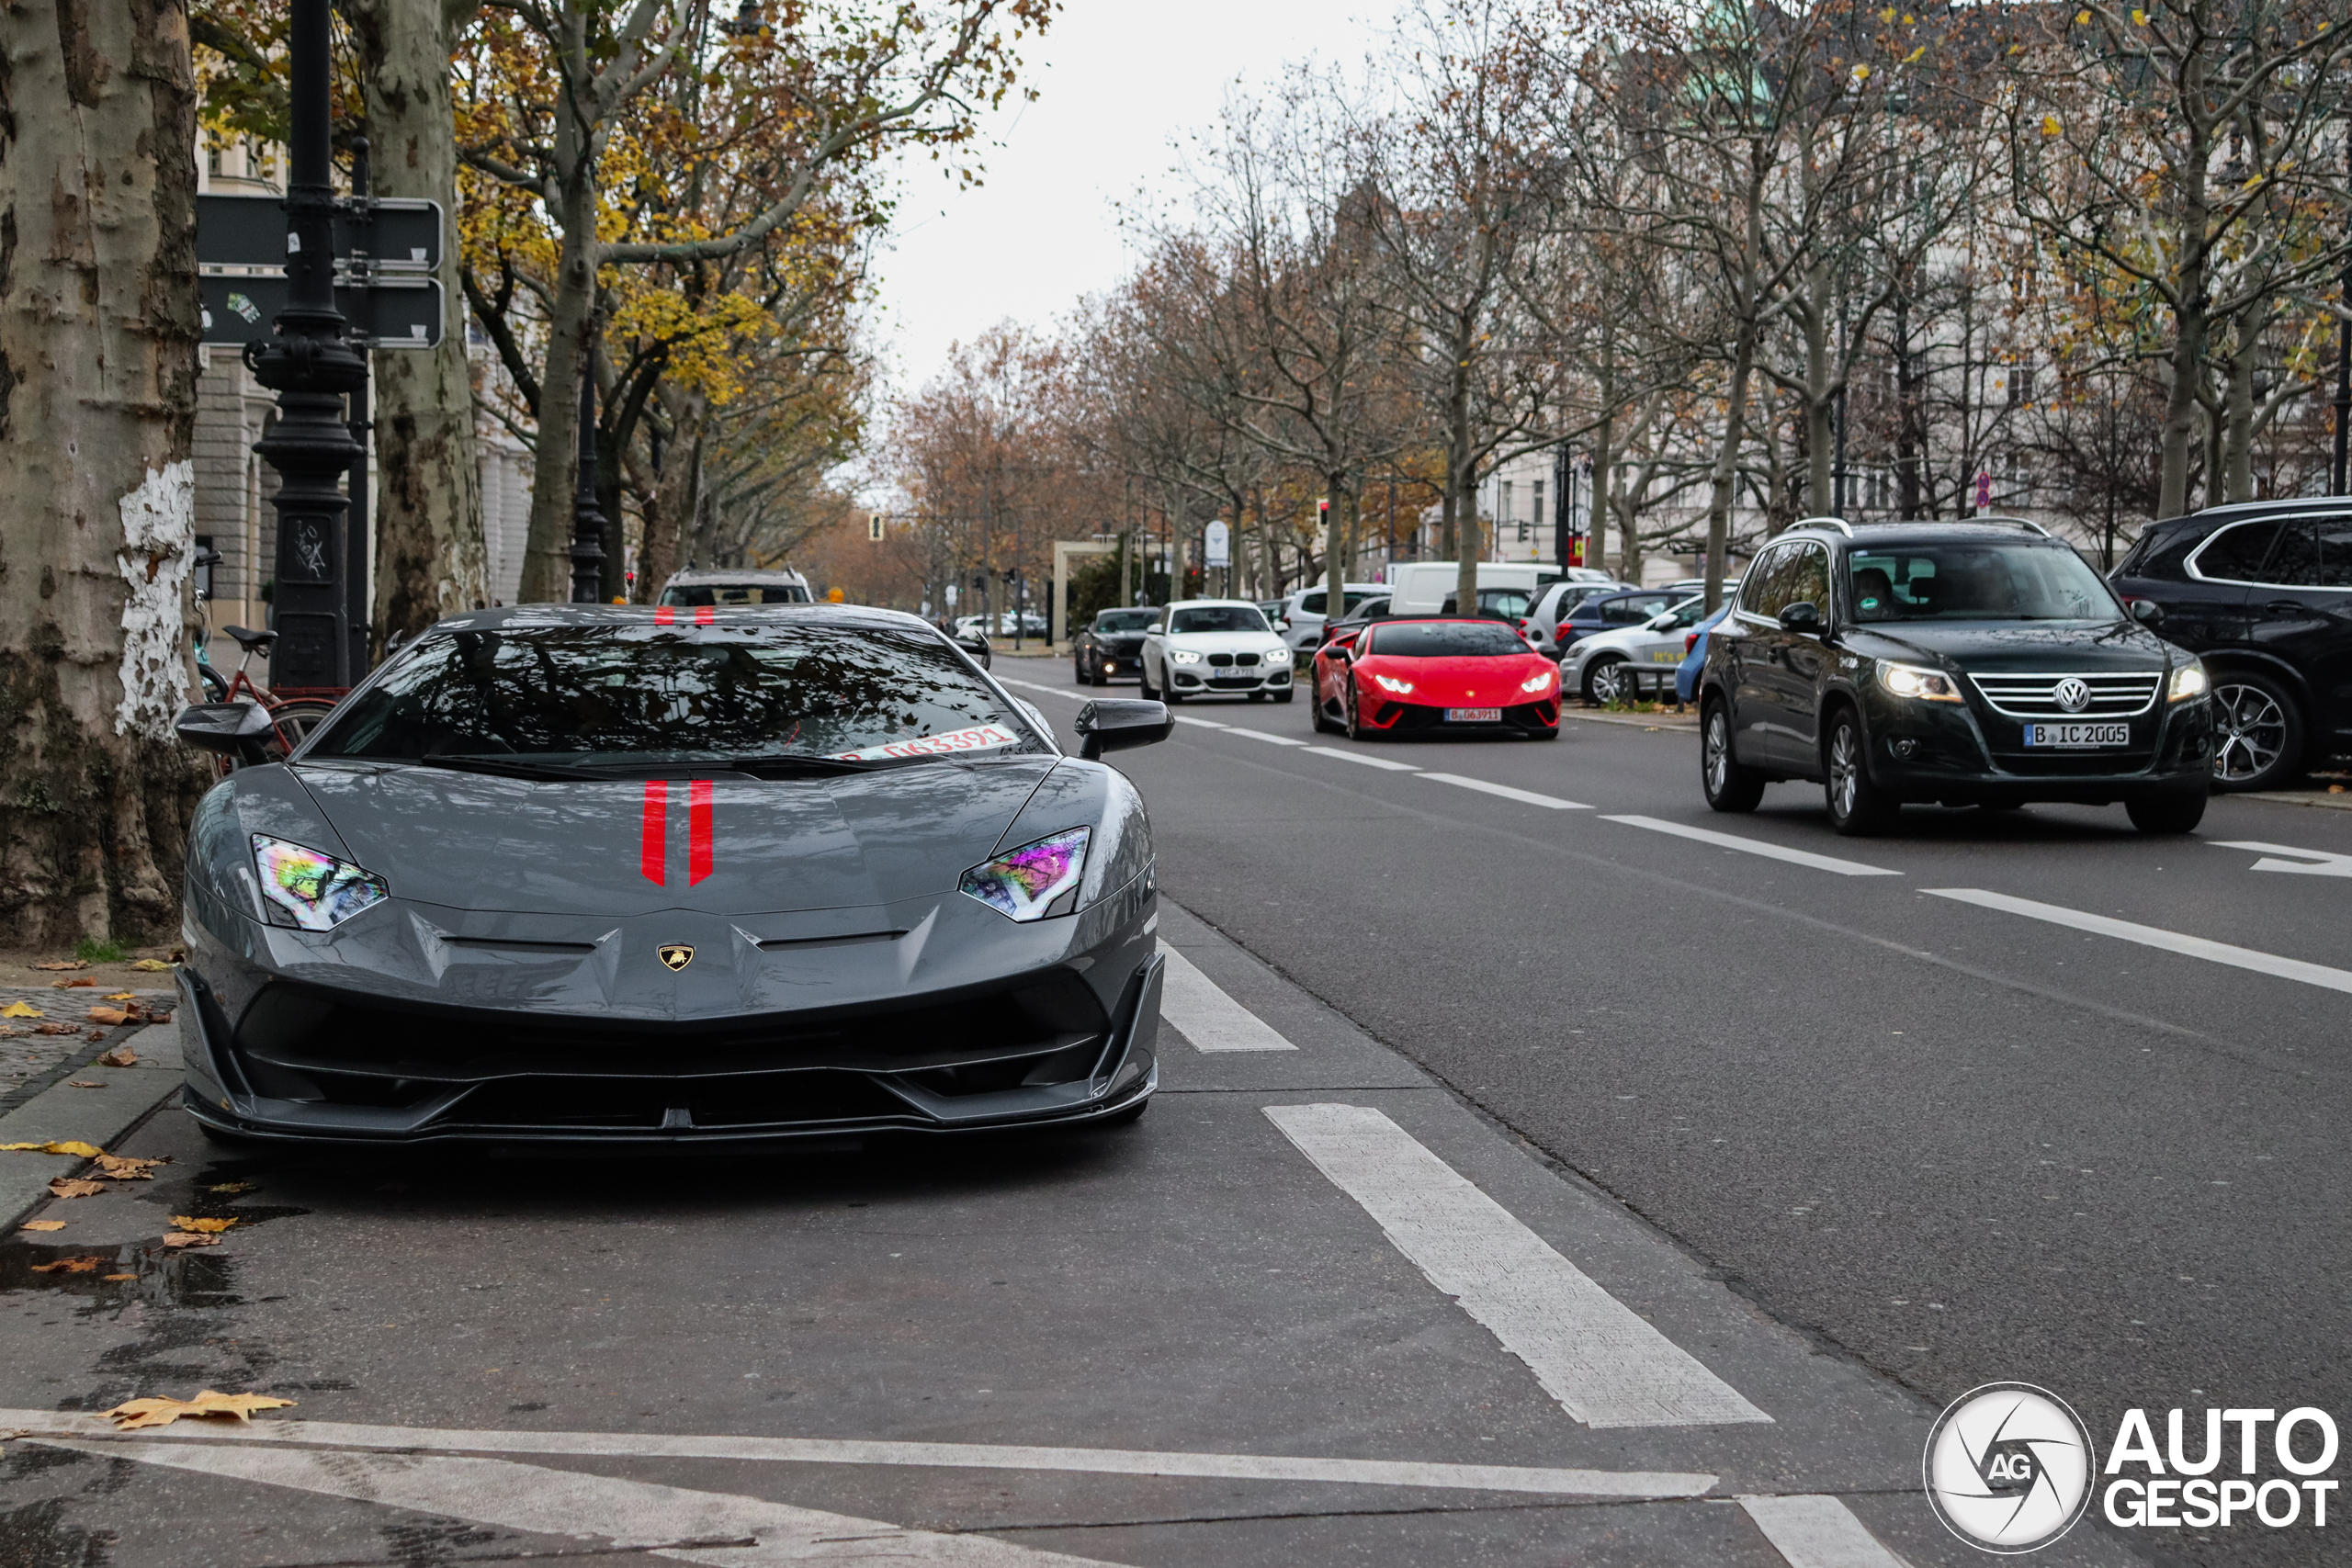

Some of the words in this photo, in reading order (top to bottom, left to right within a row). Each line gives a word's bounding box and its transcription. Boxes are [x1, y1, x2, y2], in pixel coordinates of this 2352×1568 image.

[1451, 709, 1458, 719] B
[1464, 709, 1498, 719] 063911
[2035, 727, 2046, 743] B
[2059, 727, 2080, 743] IC
[2085, 726, 2127, 743] 2005
